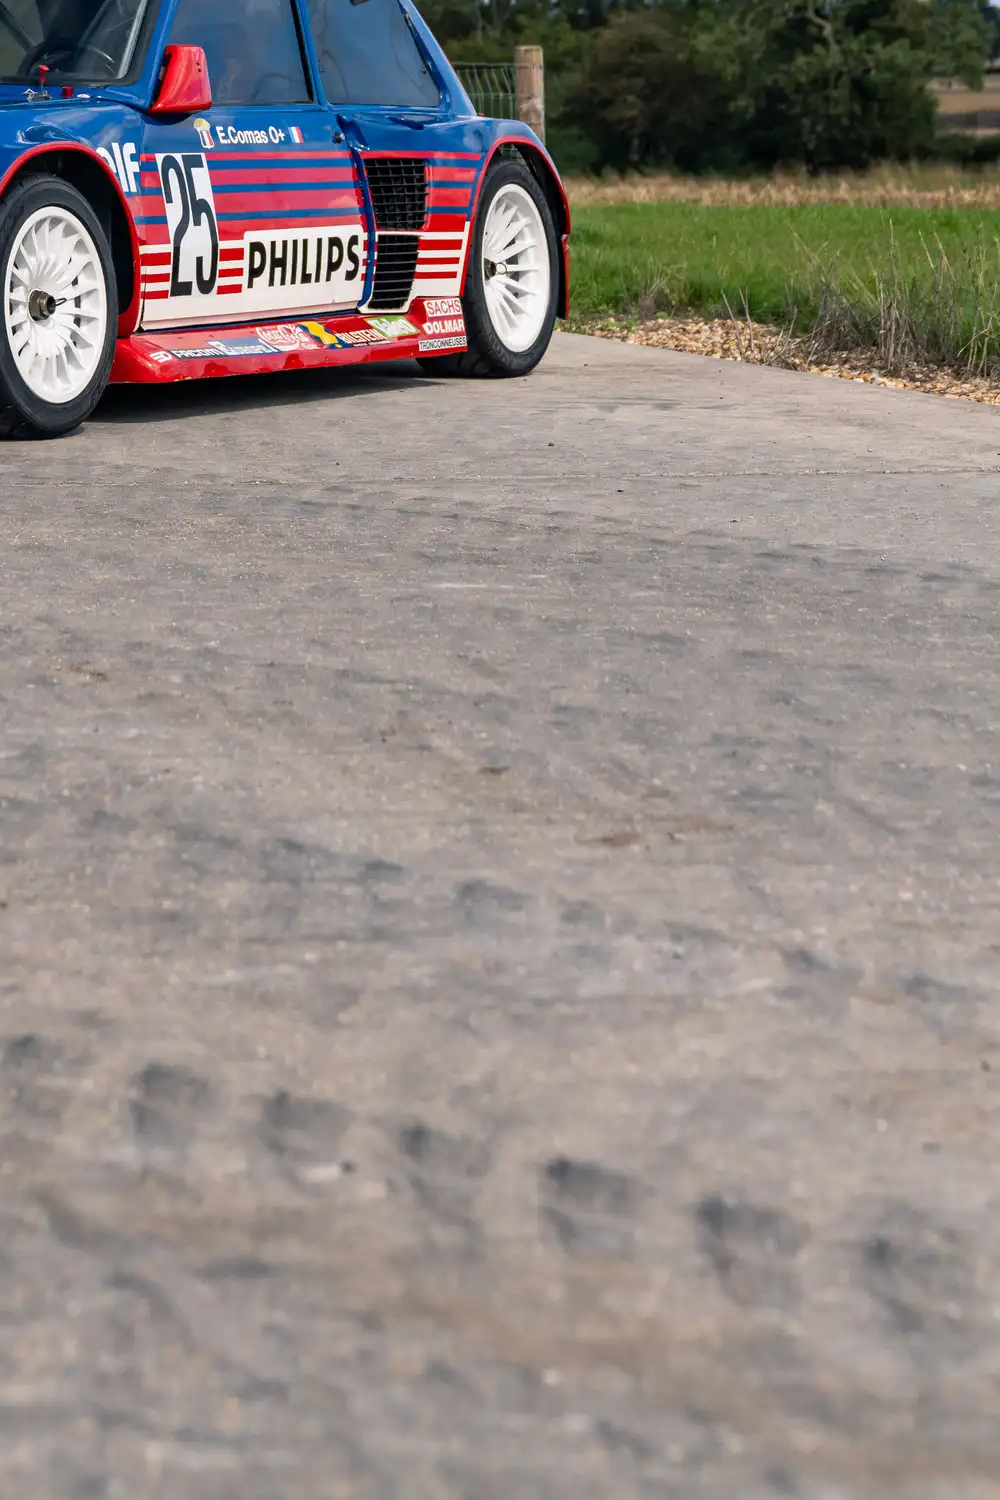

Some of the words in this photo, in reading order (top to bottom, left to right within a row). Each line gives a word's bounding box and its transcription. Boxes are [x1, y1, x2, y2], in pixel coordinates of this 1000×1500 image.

[215, 125, 268, 144] E.Comas
[161, 154, 220, 297] 25
[247, 235, 360, 289] PHILIPS
[426, 299, 461, 315] SACHS
[422, 319, 465, 334] DOLMAR
[335, 328, 388, 344] BILSTEIN
[420, 337, 466, 350] TRONCONNEUSES
